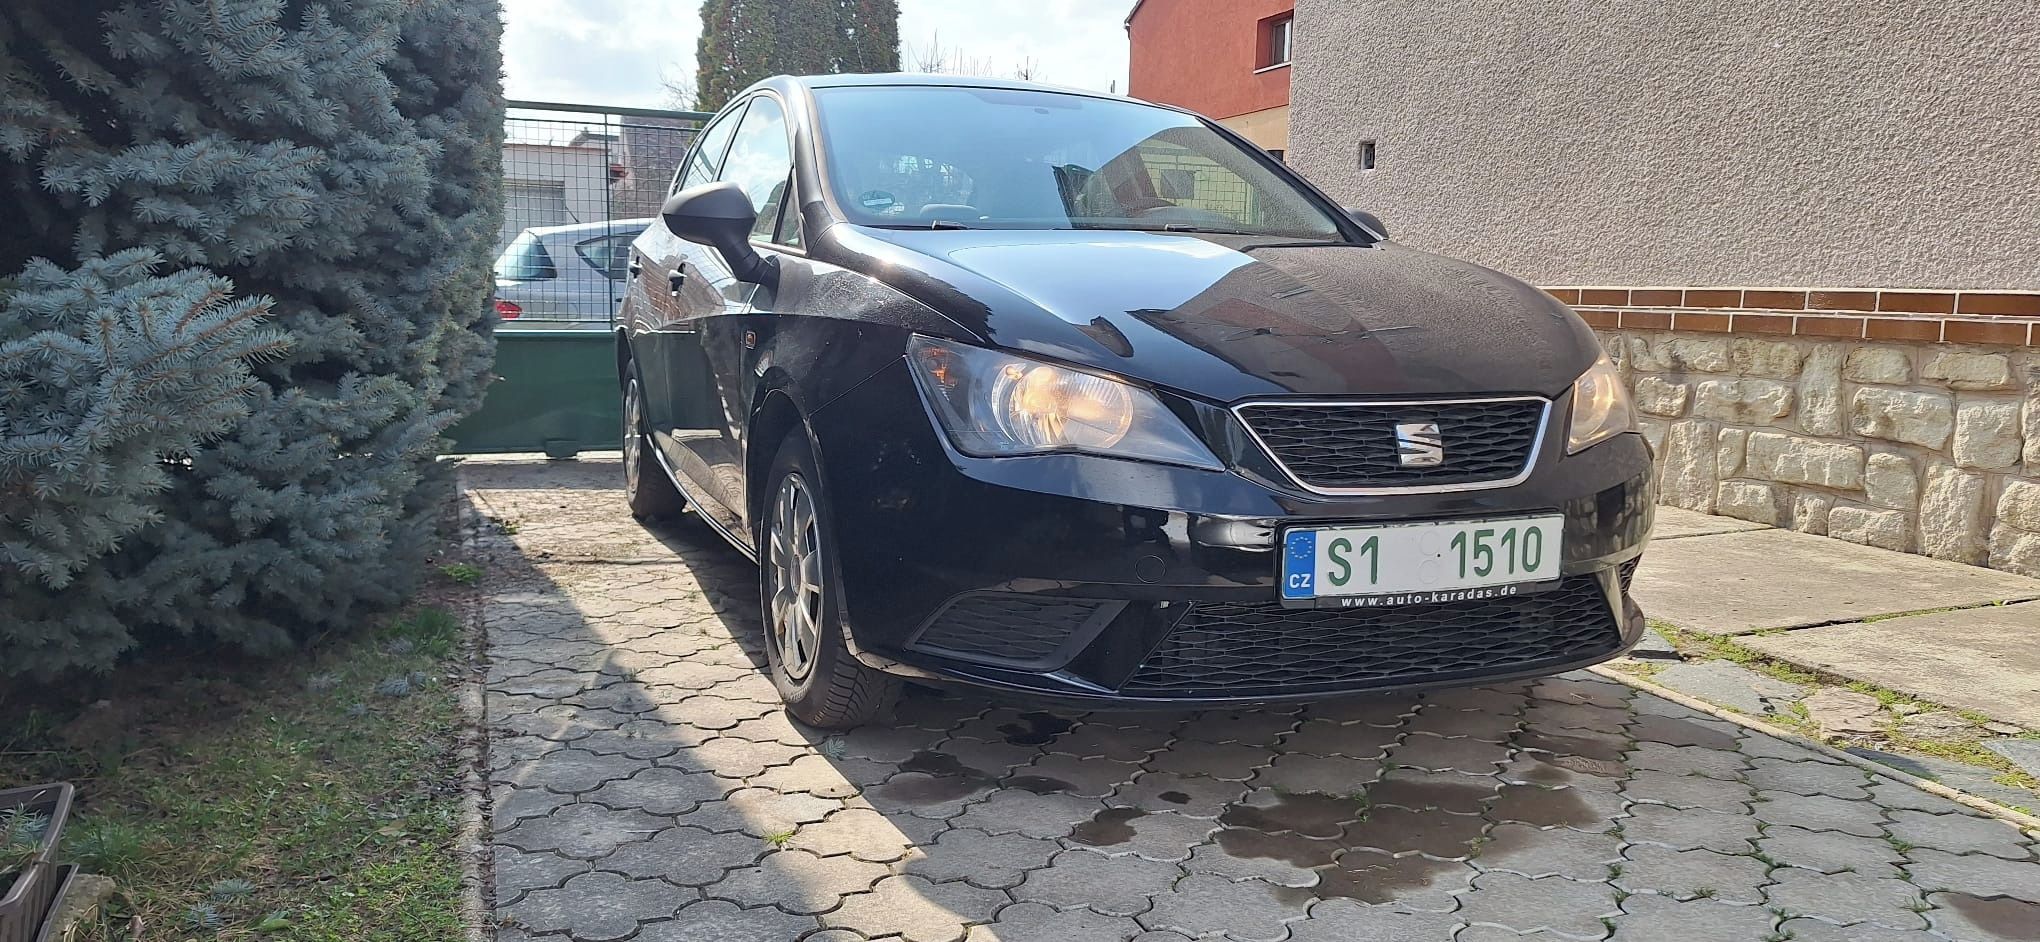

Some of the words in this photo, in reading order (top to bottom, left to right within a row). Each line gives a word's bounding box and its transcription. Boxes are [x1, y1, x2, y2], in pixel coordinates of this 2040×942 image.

[1327, 535, 1379, 587] S1
[1450, 525, 1543, 579] 1510
[1289, 573, 1311, 589] CZ
[1341, 584, 1518, 607] www.auto-karadas.de
